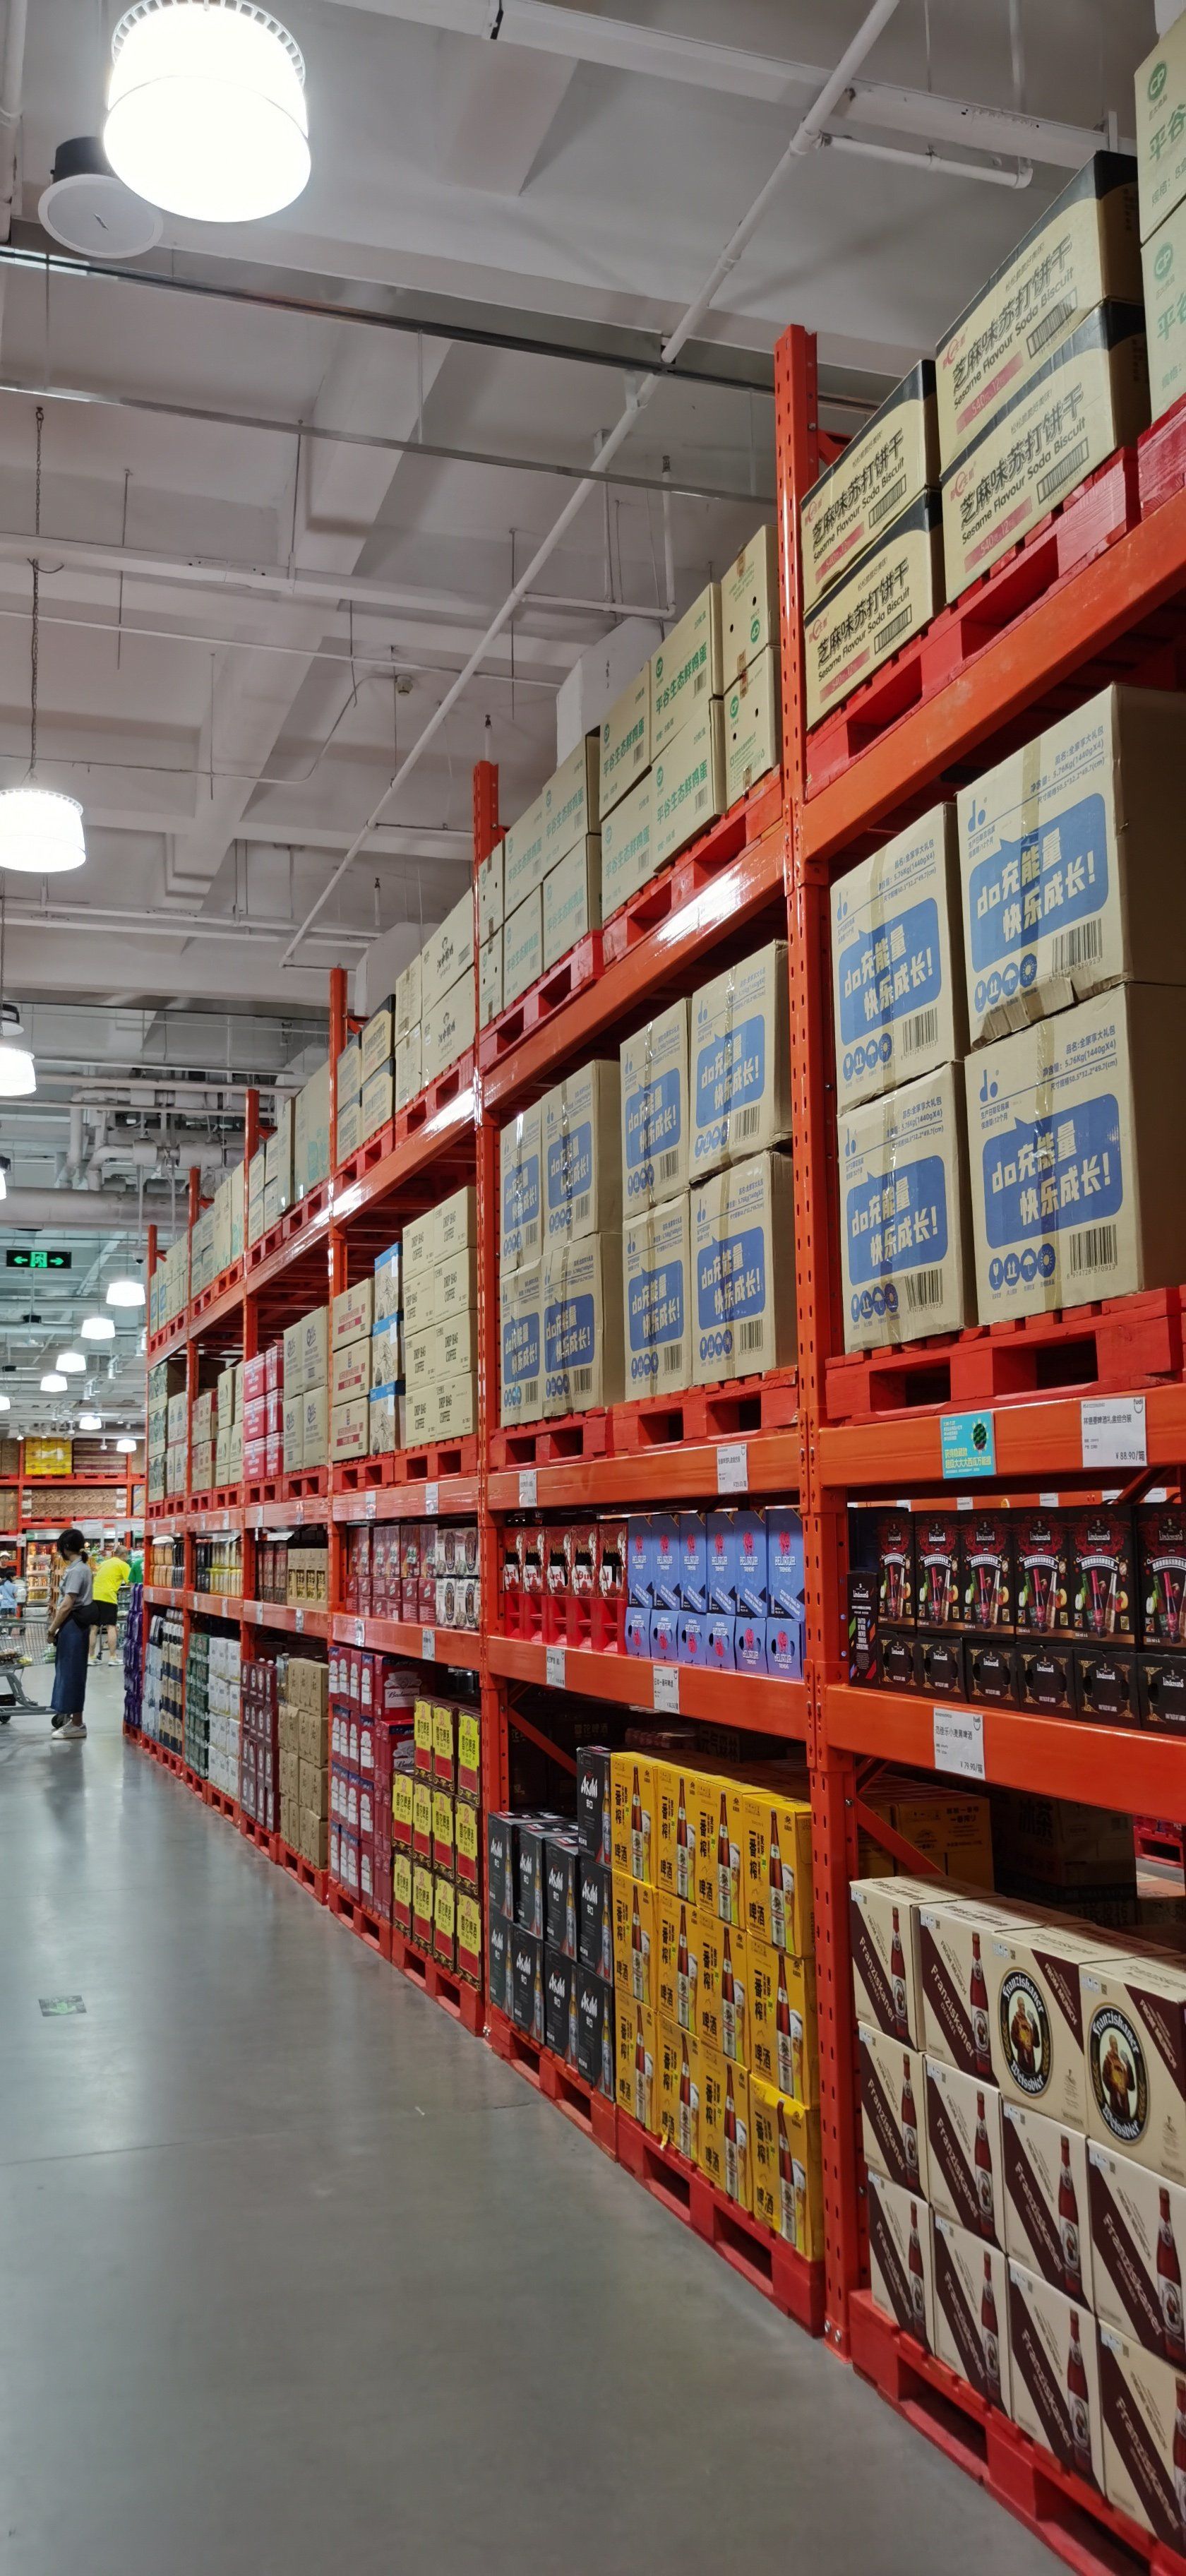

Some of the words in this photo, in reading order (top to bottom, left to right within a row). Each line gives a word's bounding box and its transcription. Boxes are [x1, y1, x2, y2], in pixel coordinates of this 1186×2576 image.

[952, 233, 1072, 396] 芝麻味苏打饼干
[954, 370, 982, 410] Sesame
[983, 336, 1013, 374] Flavour
[1015, 309, 1038, 337] Soda
[1041, 267, 1074, 307] Biscuit
[813, 427, 904, 551] 芝麻味苏打饼干
[960, 382, 1084, 531] 芝麻味苏打饼干
[962, 511, 993, 545] Sesame
[994, 475, 1026, 511] Flavour
[1027, 453, 1051, 480] Soda
[1054, 417, 1086, 454] Biscuit
[813, 534, 835, 564] Sesame
[837, 506, 861, 537] Flavour
[862, 489, 880, 510] Soda
[882, 456, 904, 485] Biscuit
[817, 556, 909, 670] 芝麻味苏打饼干
[818, 655, 841, 682] Sesame
[842, 629, 866, 659] Flavour
[868, 612, 885, 633] Soda
[887, 586, 910, 615] Biscuit
[977, 827, 1062, 919] do充能量
[844, 924, 906, 999] do充能量
[992, 1119, 1077, 1194] do充能量
[581, 1775, 598, 1798] Asahi
[491, 1837, 503, 1859] Asahi
[520, 1853, 532, 1875] Asahi
[549, 1868, 563, 1892] Asahi
[582, 1880, 598, 1904] Asahi
[491, 1928, 503, 1950] Asahi
[516, 1951, 531, 1975] Asahi
[549, 1972, 565, 1998] Asahi
[581, 1991, 598, 2018] Asahi
[860, 1937, 895, 2022] Franziskaner
[931, 1964, 974, 2057] Franziskaner
